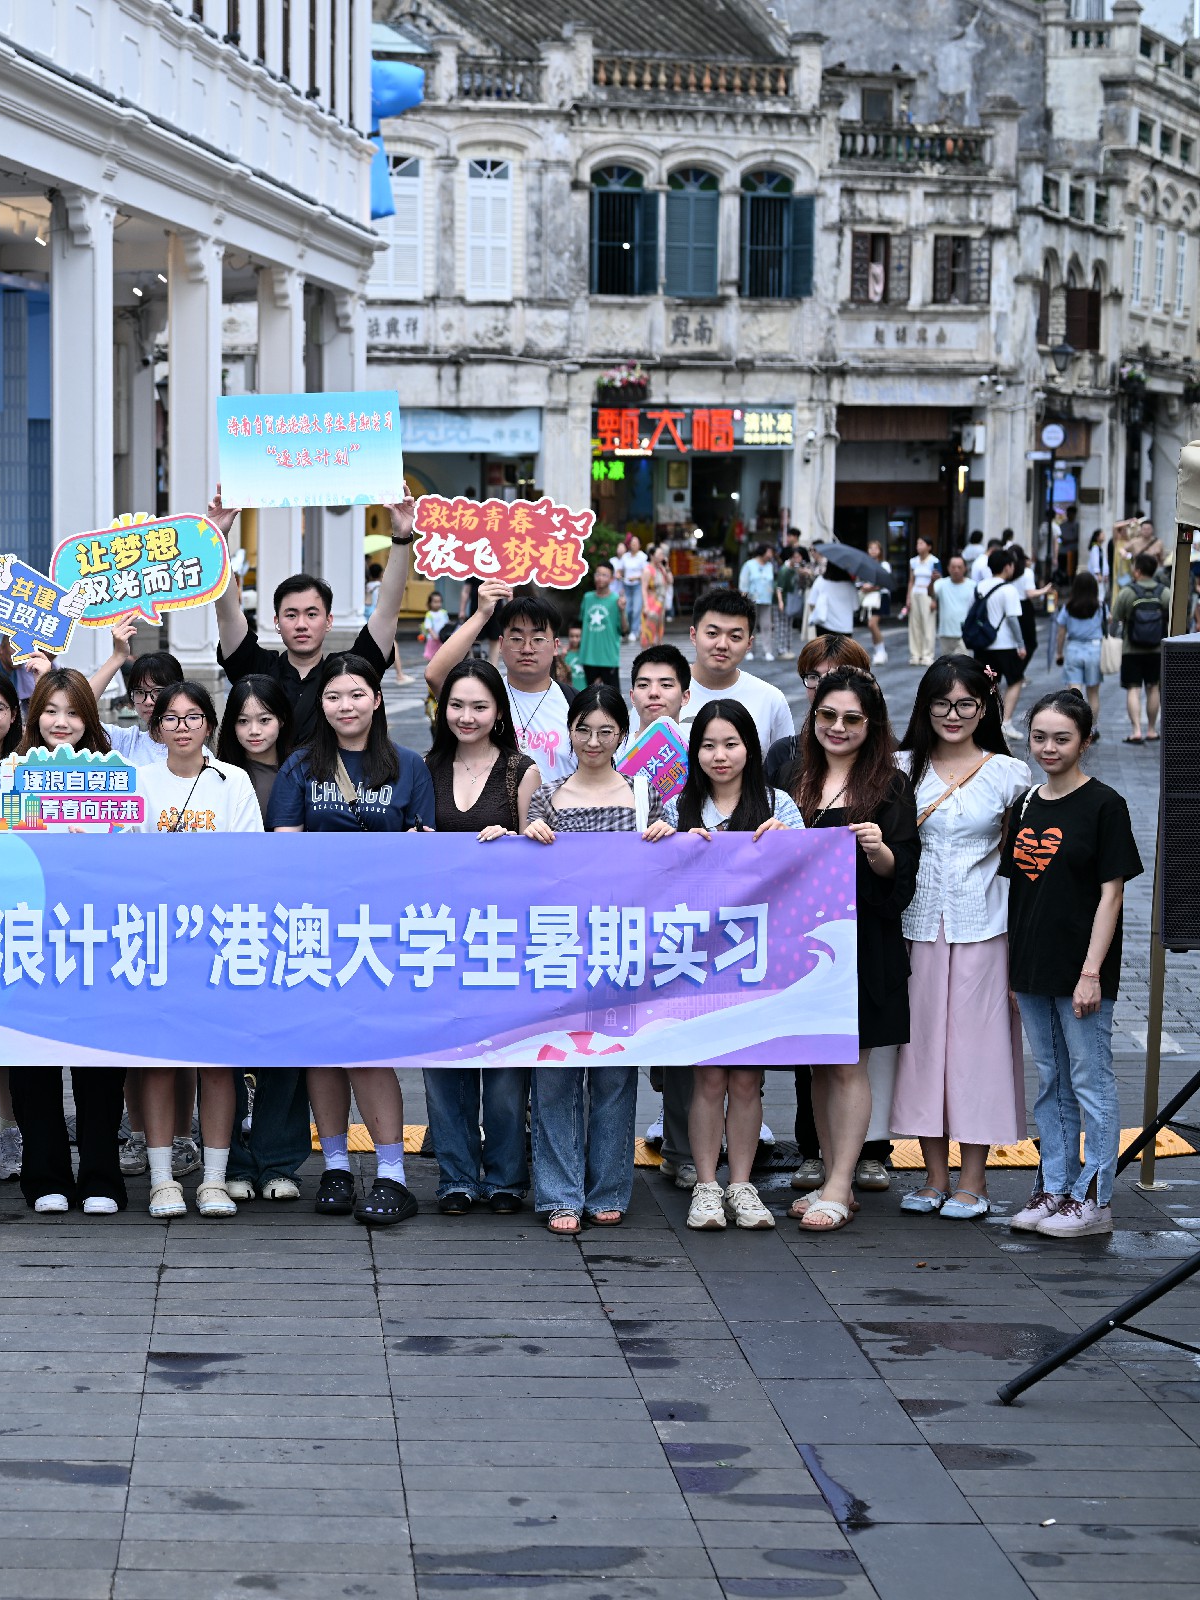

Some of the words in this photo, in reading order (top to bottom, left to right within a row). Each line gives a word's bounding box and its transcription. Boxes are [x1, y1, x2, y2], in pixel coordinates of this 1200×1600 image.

[420, 502, 536, 535] 激扬青春
[75, 527, 182, 577] 让梦想
[422, 532, 580, 582] 放飞梦想
[9, 576, 57, 611] 共建
[22, 770, 129, 791] 逐浪自贸港
[41, 799, 140, 820] 青春向未来
